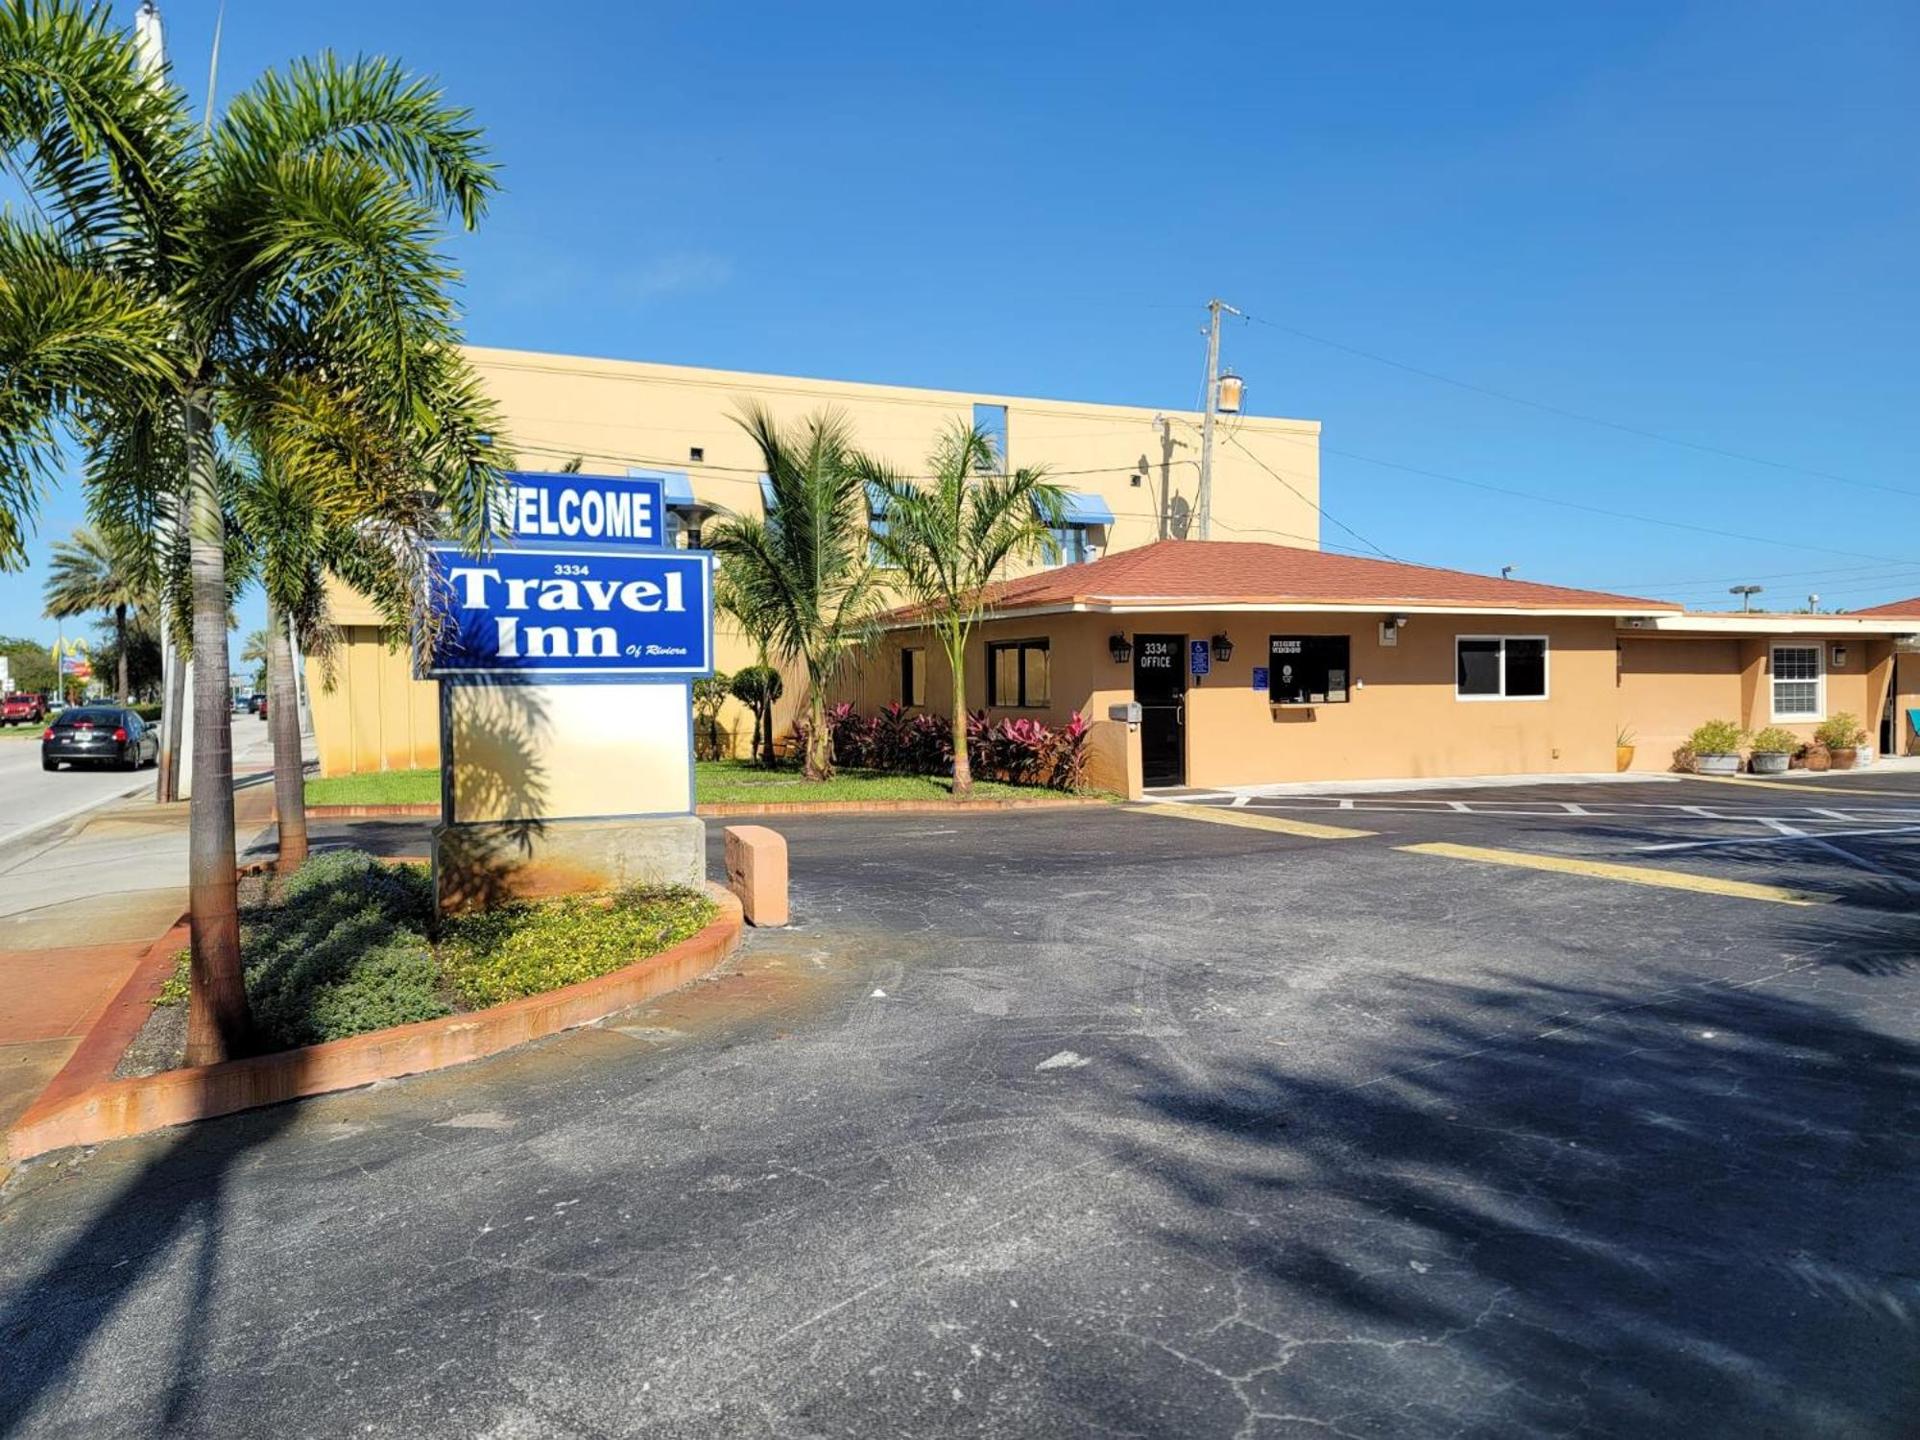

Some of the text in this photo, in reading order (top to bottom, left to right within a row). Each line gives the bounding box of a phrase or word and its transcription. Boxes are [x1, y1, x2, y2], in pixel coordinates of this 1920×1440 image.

[487, 486, 652, 538] WELCOME
[554, 564, 589, 576] 3334
[450, 567, 686, 612] Travel
[494, 616, 621, 657] Inn
[625, 644, 688, 658] Of Riviera
[1144, 643, 1167, 655] 3334
[1140, 656, 1171, 668] OFFICE
